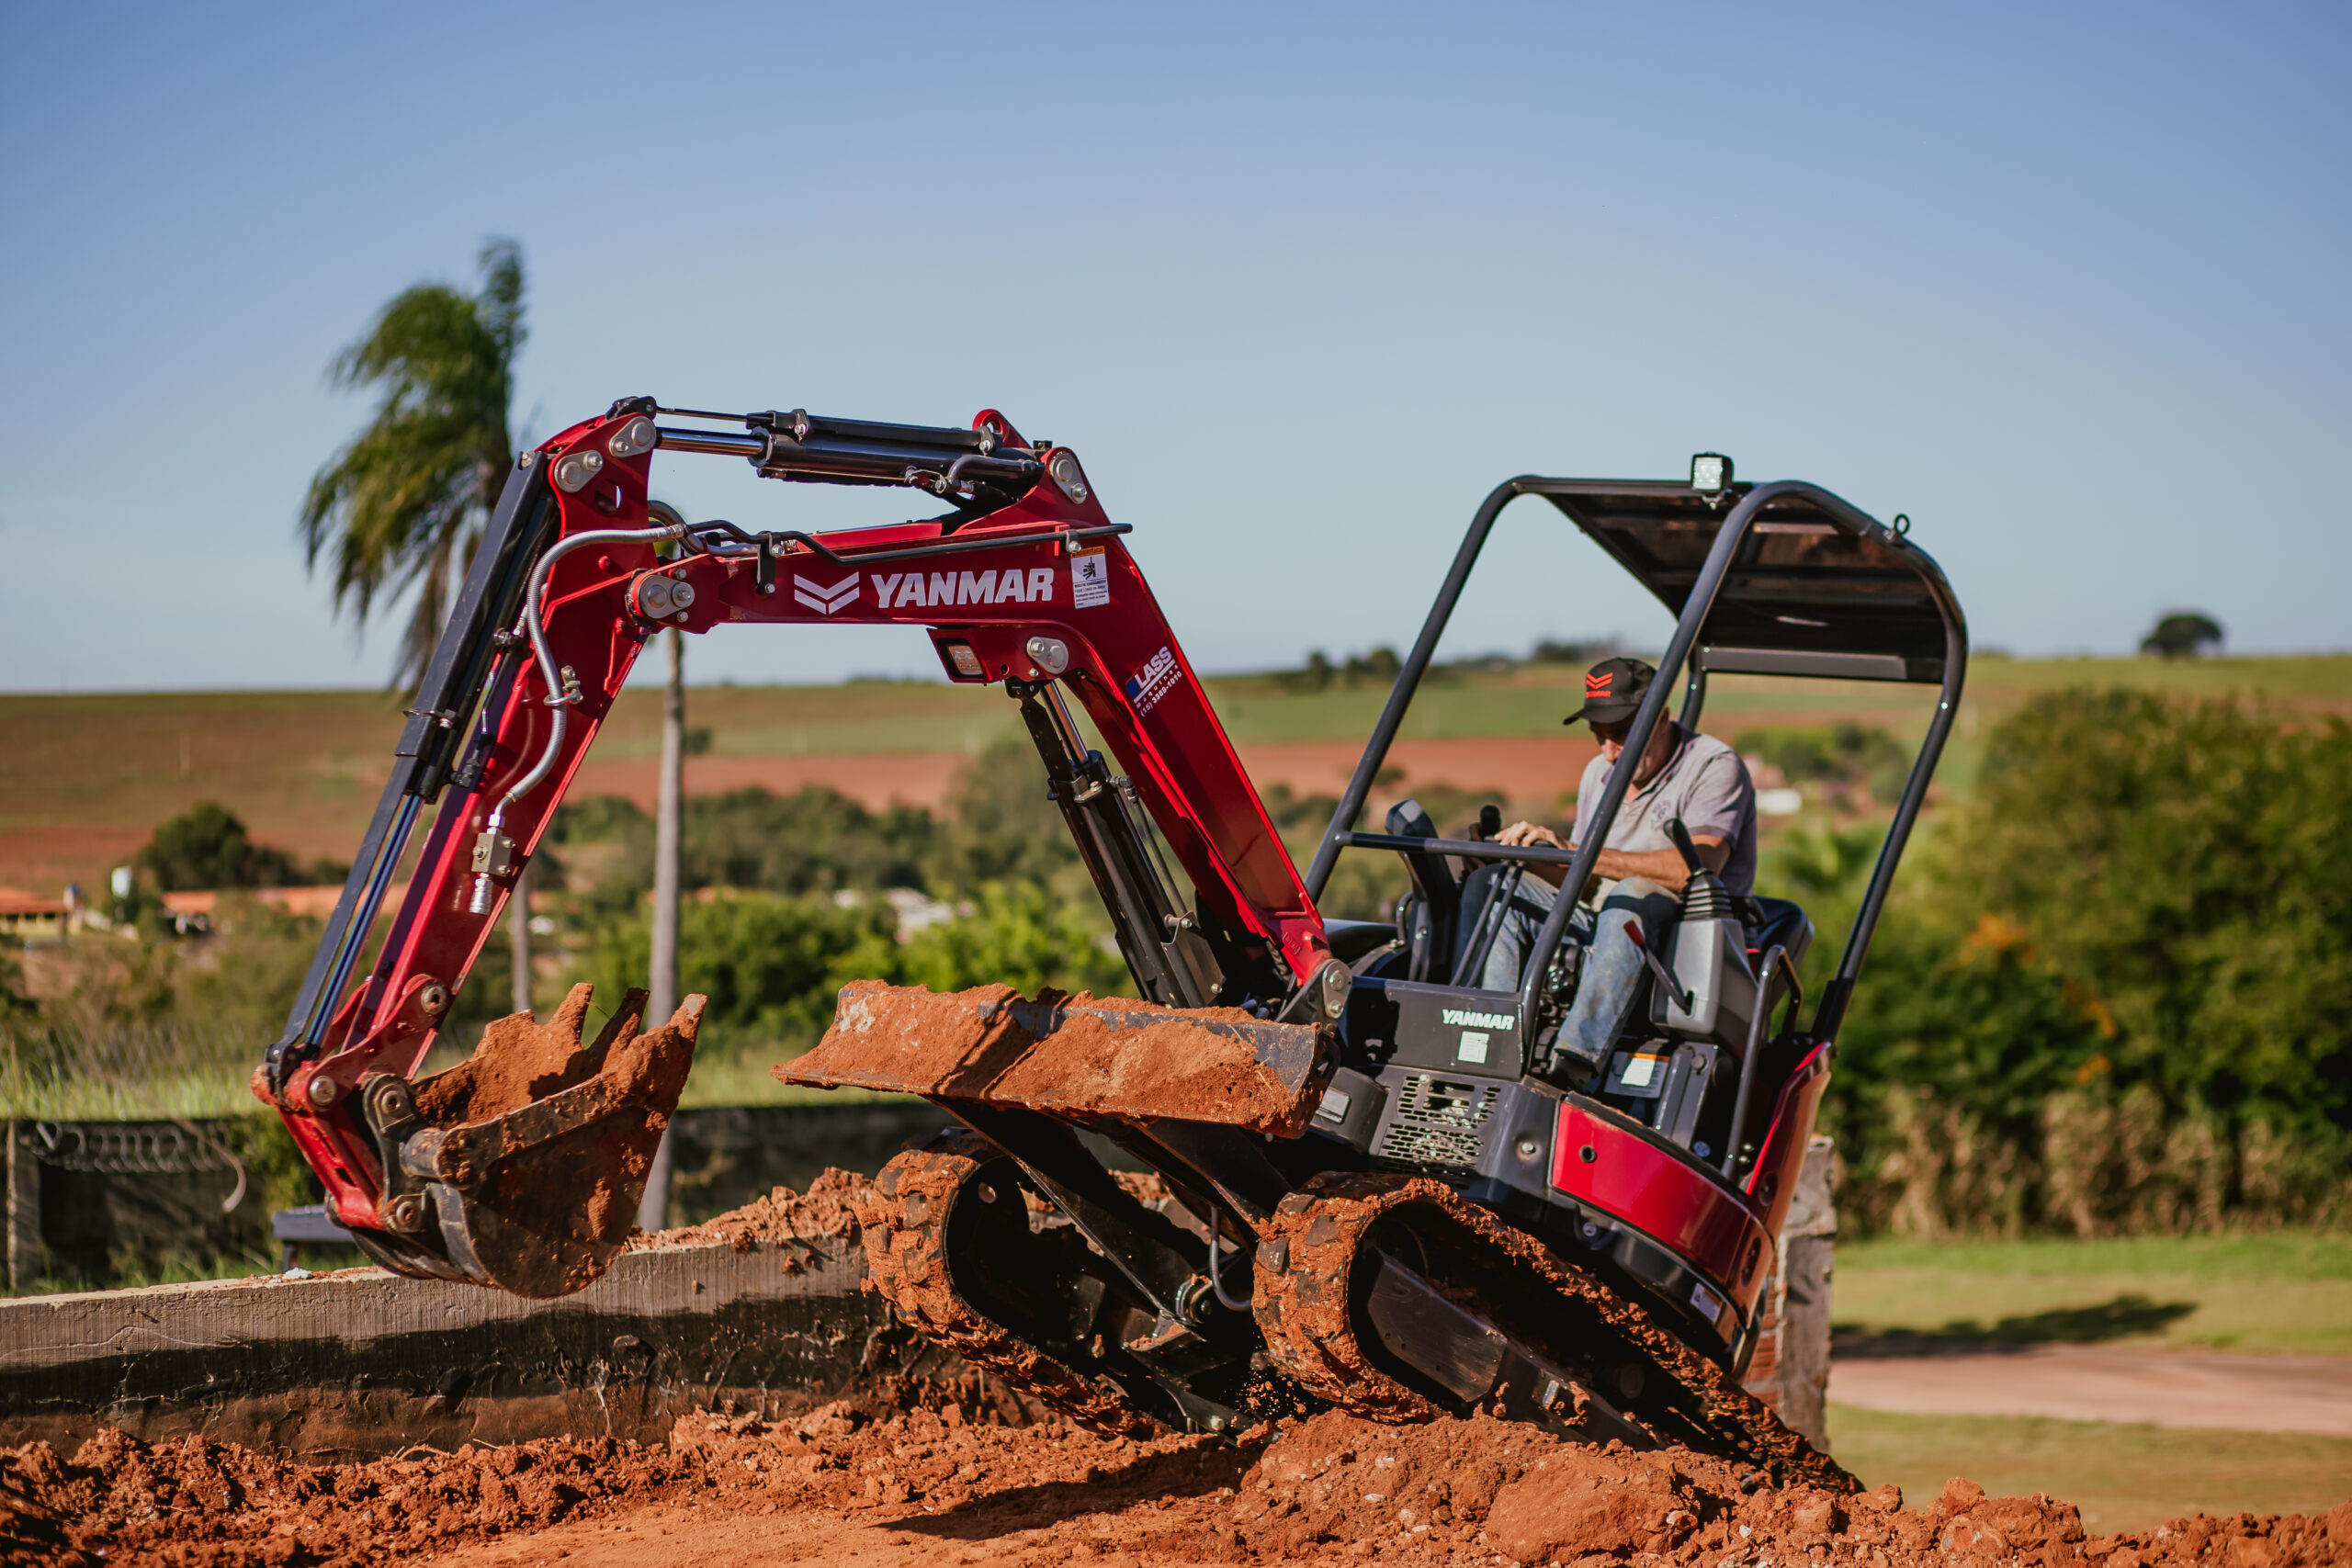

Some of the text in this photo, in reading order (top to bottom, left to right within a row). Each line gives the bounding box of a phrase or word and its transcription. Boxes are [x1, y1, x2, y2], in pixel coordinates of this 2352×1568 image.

[871, 568, 1055, 609] YANMAR
[1135, 646, 1172, 689] LASS
[1139, 671, 1182, 717] (15) 3389-1010
[1442, 1009, 1515, 1031] YANMAR
